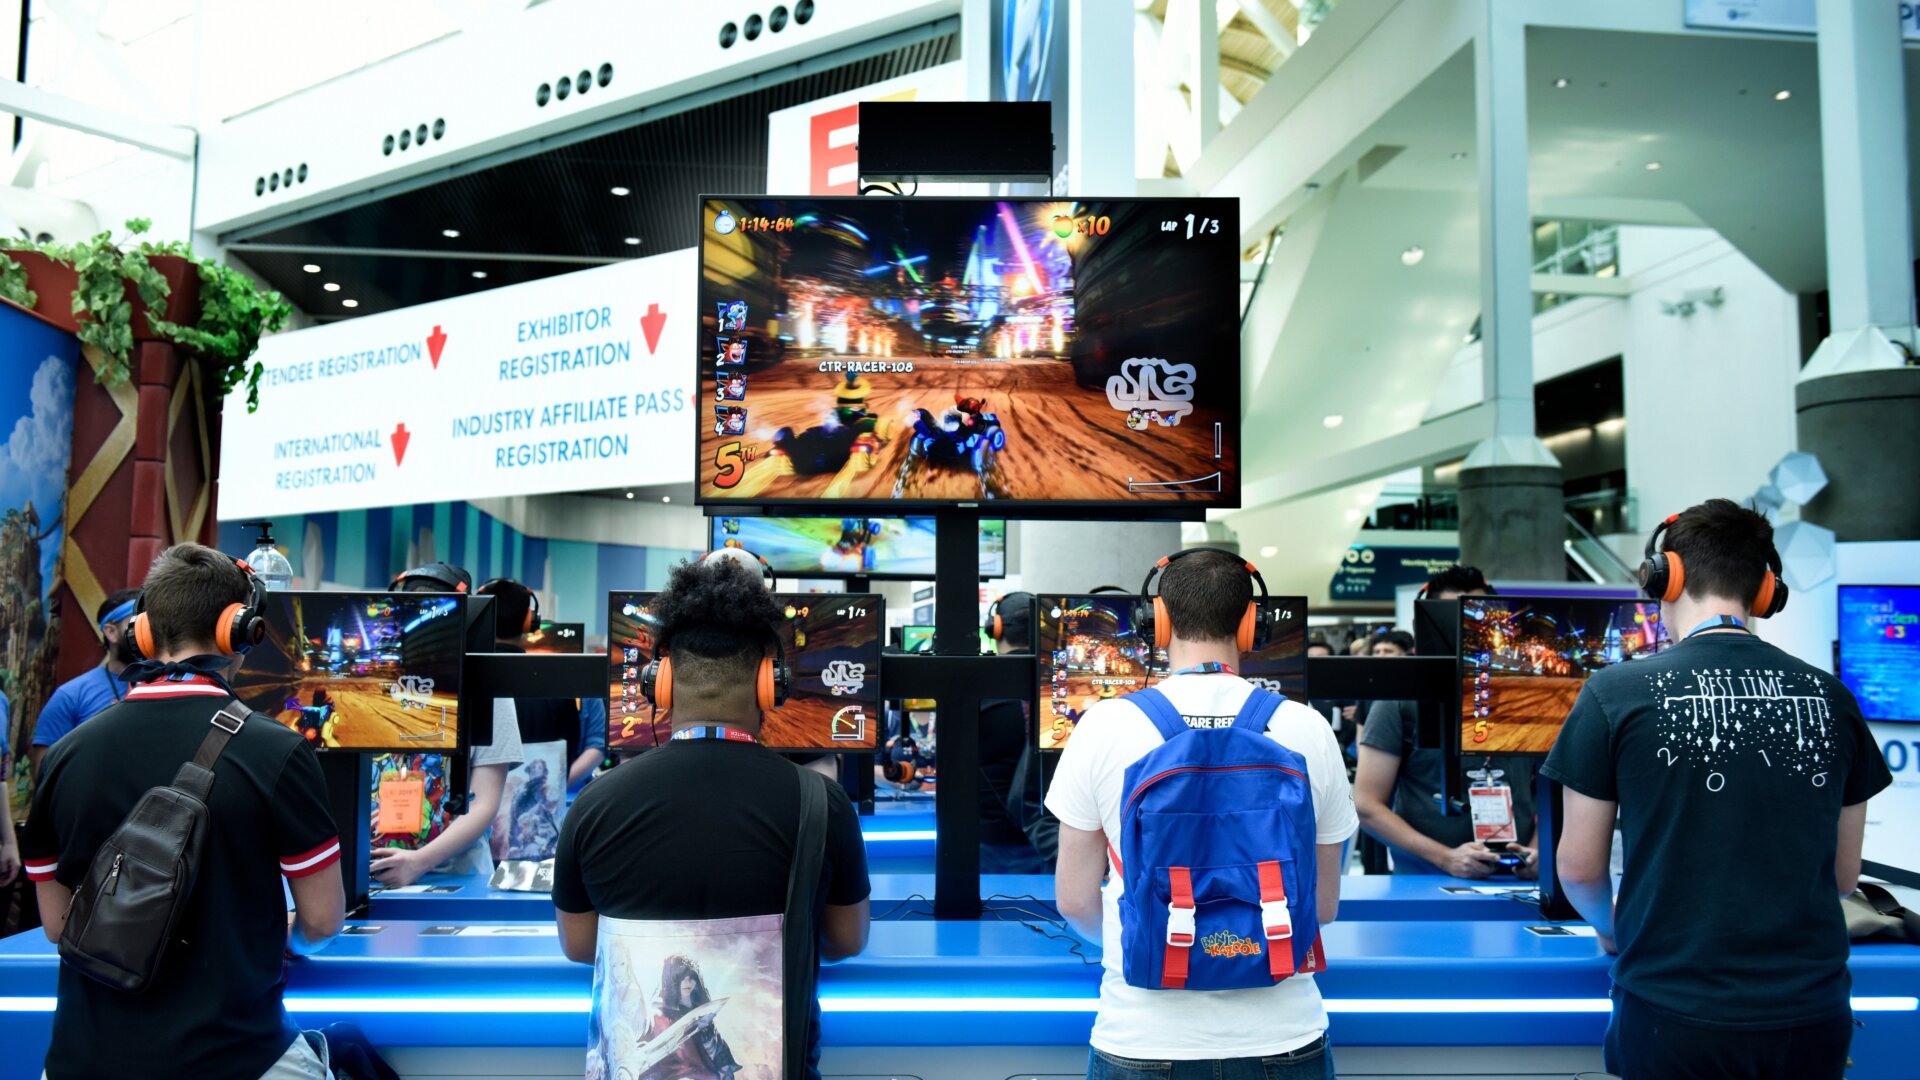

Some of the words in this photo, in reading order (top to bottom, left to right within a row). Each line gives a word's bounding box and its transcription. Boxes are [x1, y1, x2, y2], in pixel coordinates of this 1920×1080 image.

[740, 216, 795, 233] 1:14:64
[1160, 221, 1178, 231] LAP
[1184, 213, 1220, 240] 1/3
[518, 307, 612, 343] EXHIBITOR
[718, 318, 724, 333] 1
[263, 362, 314, 387] TENDEE
[318, 341, 422, 377] REGISTRATION
[499, 340, 630, 381] REGISTRATION
[716, 353, 725, 366] 2
[818, 360, 914, 374] CTR-RACER-108
[715, 388, 725, 402] 3
[452, 408, 535, 438] INDUSTRY
[539, 396, 628, 428] AFFILIATE
[634, 388, 684, 417] PASS
[715, 422, 725, 436] 4
[274, 429, 381, 460] INTERNATIONAL
[495, 433, 628, 469] REGISTRATION
[275, 462, 376, 490] REGISTRATION
[1745, 669, 1785, 677] TIME
[1697, 674, 1734, 697] BEST
[1738, 676, 1783, 697] TIME
[1214, 716, 1236, 729] REP
